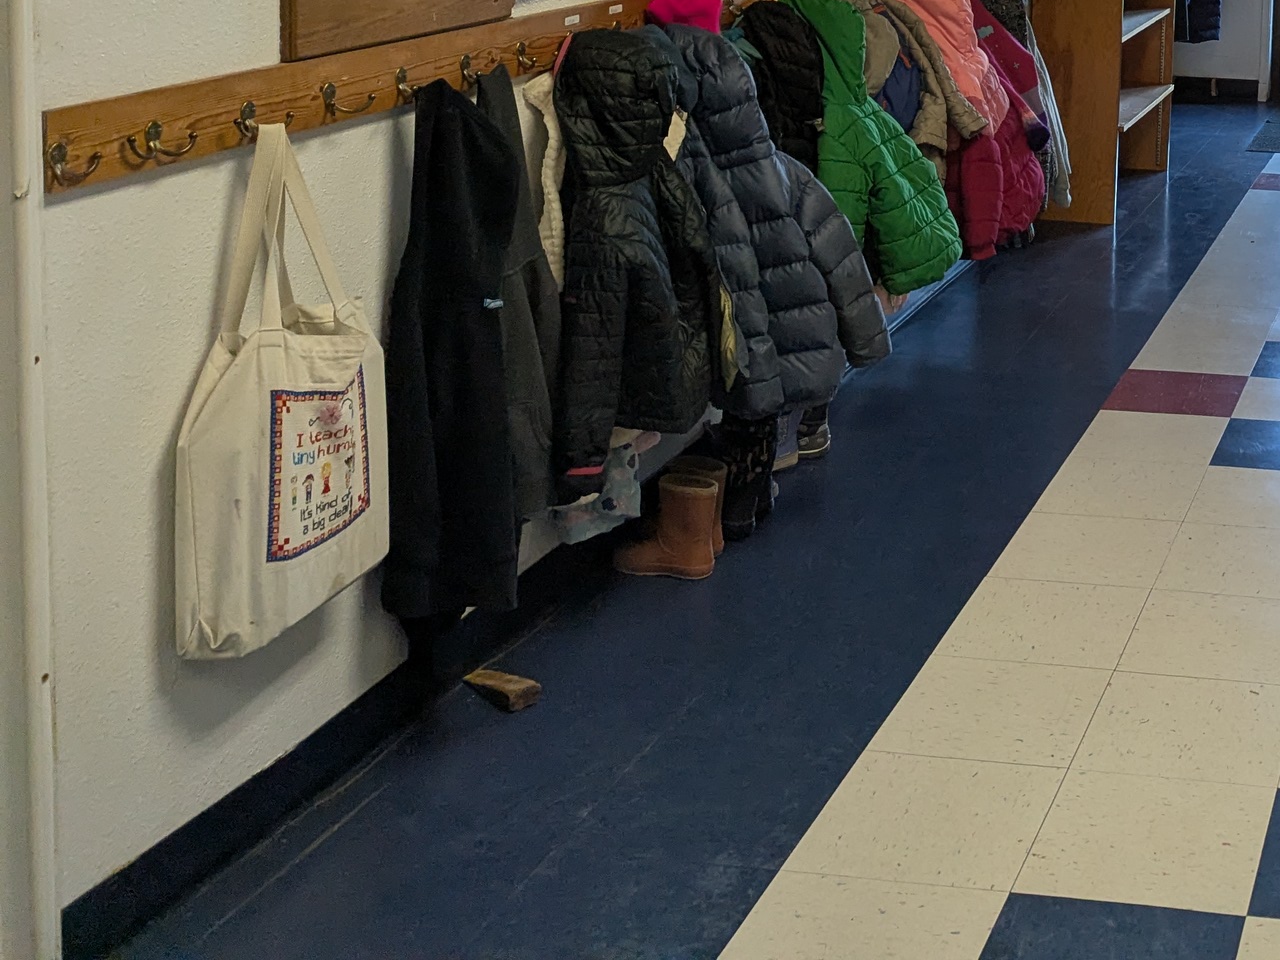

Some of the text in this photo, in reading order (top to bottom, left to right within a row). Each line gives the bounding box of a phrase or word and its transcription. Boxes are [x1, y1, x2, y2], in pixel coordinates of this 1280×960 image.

[296, 424, 352, 448] I teach
[293, 450, 315, 466] tiny
[300, 506, 313, 522] It's
[303, 524, 309, 535] a
[312, 517, 325, 531] big
